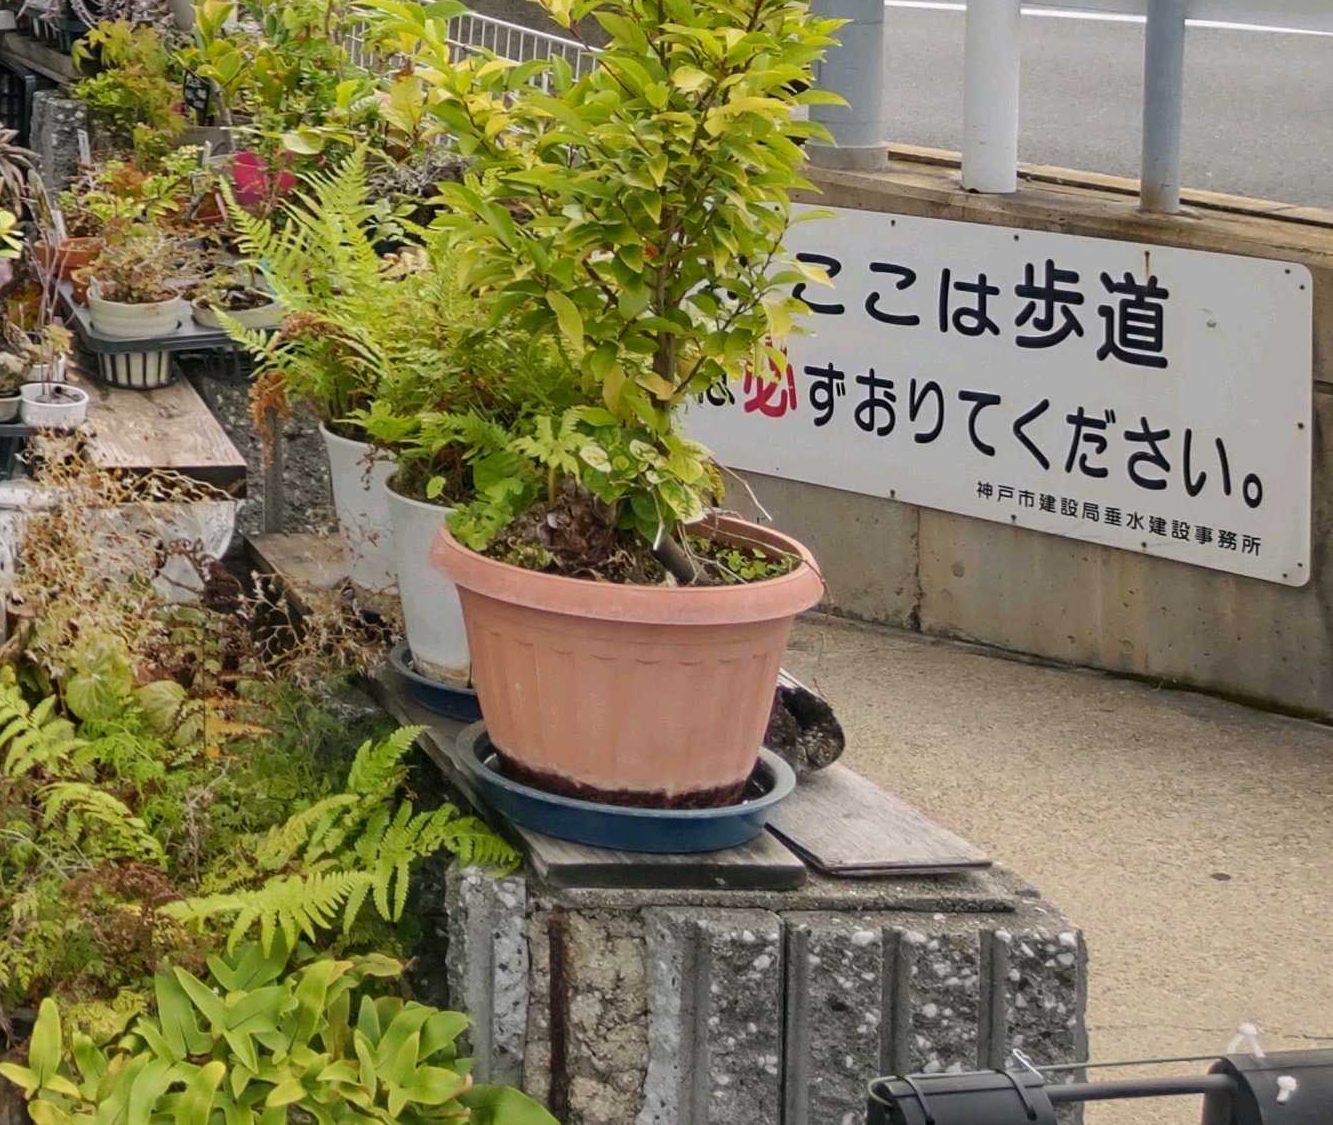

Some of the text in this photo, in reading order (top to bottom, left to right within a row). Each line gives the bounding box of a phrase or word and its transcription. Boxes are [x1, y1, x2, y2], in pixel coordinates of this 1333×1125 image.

[794, 251, 1169, 369] ここは歩道
[975, 480, 1263, 557] 神戸市建設局垂水建設事務所
